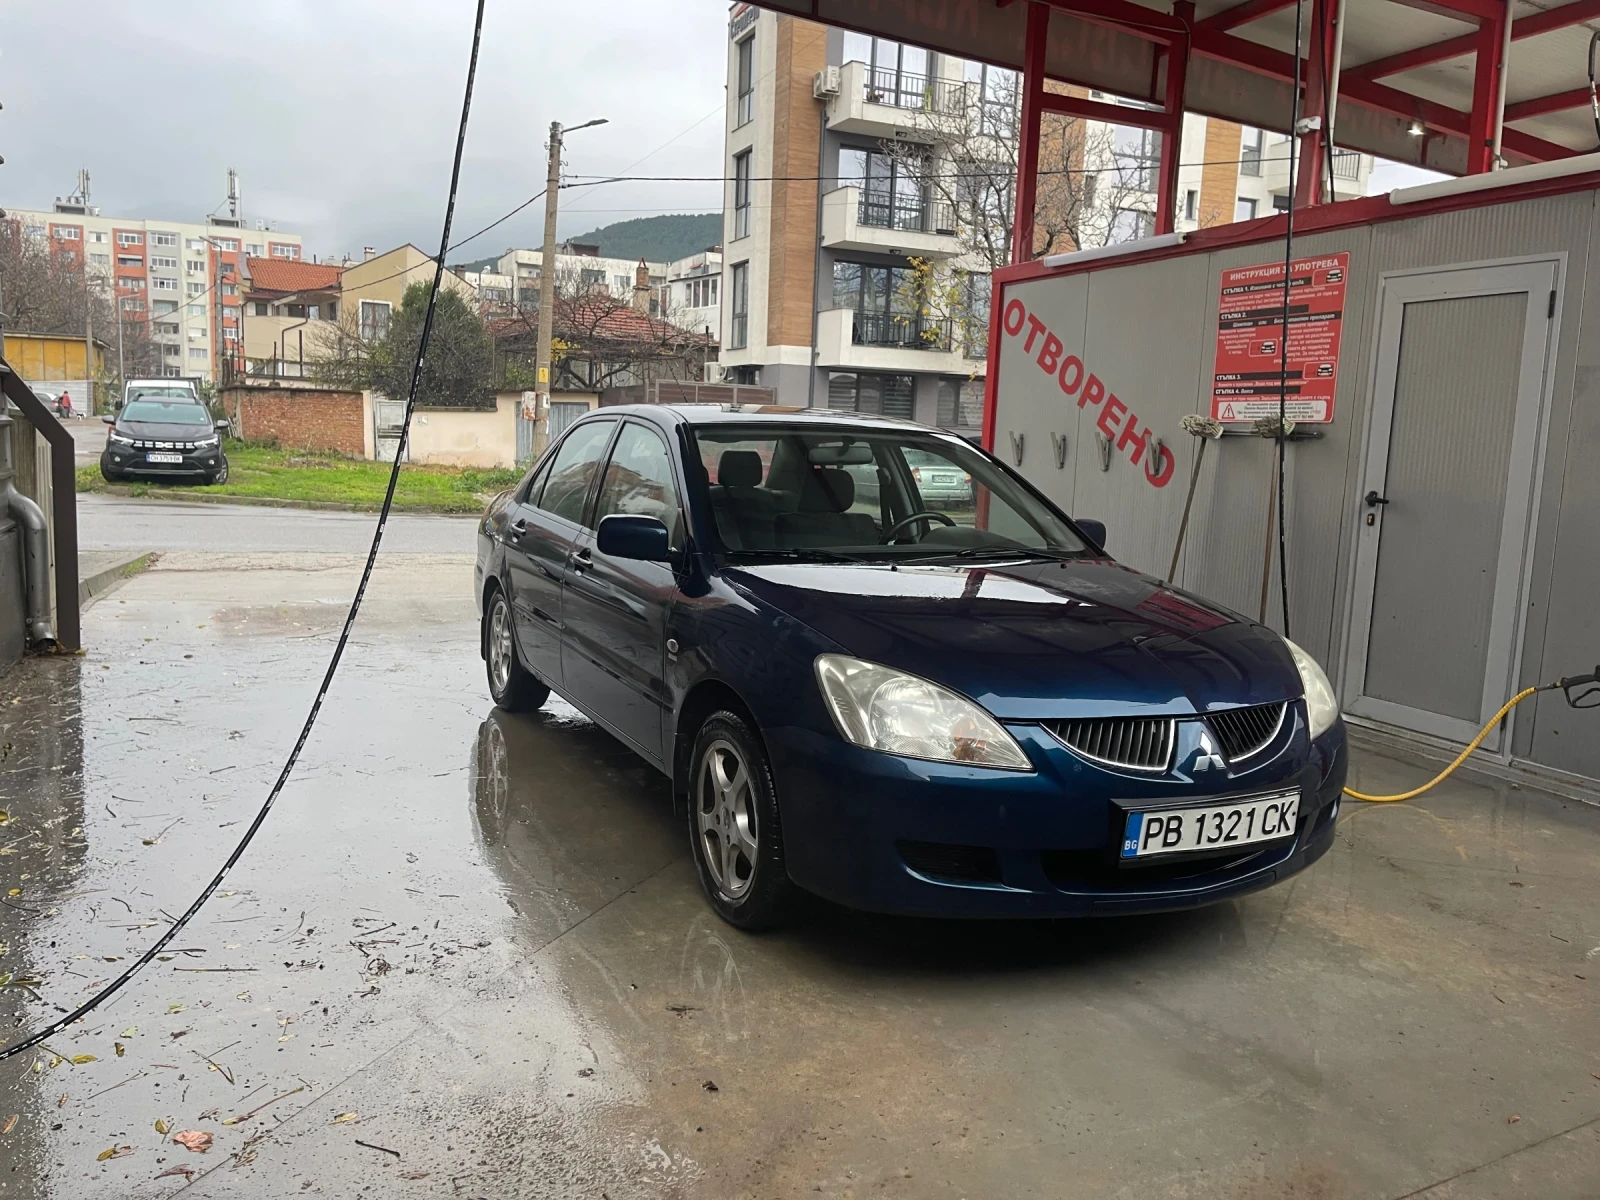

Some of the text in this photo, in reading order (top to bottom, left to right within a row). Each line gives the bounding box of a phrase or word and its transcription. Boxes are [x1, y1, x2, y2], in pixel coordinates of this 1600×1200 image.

[1230, 266, 1280, 280] ИНСТРУКЦИЯ
[1294, 258, 1338, 272] УПОТРЕБА
[1223, 286, 1244, 294] СТЪПКА
[1004, 298, 1175, 488] ОТВОРЕНО
[1142, 800, 1295, 850] PB 1321 CK
[1124, 840, 1138, 850] BG
